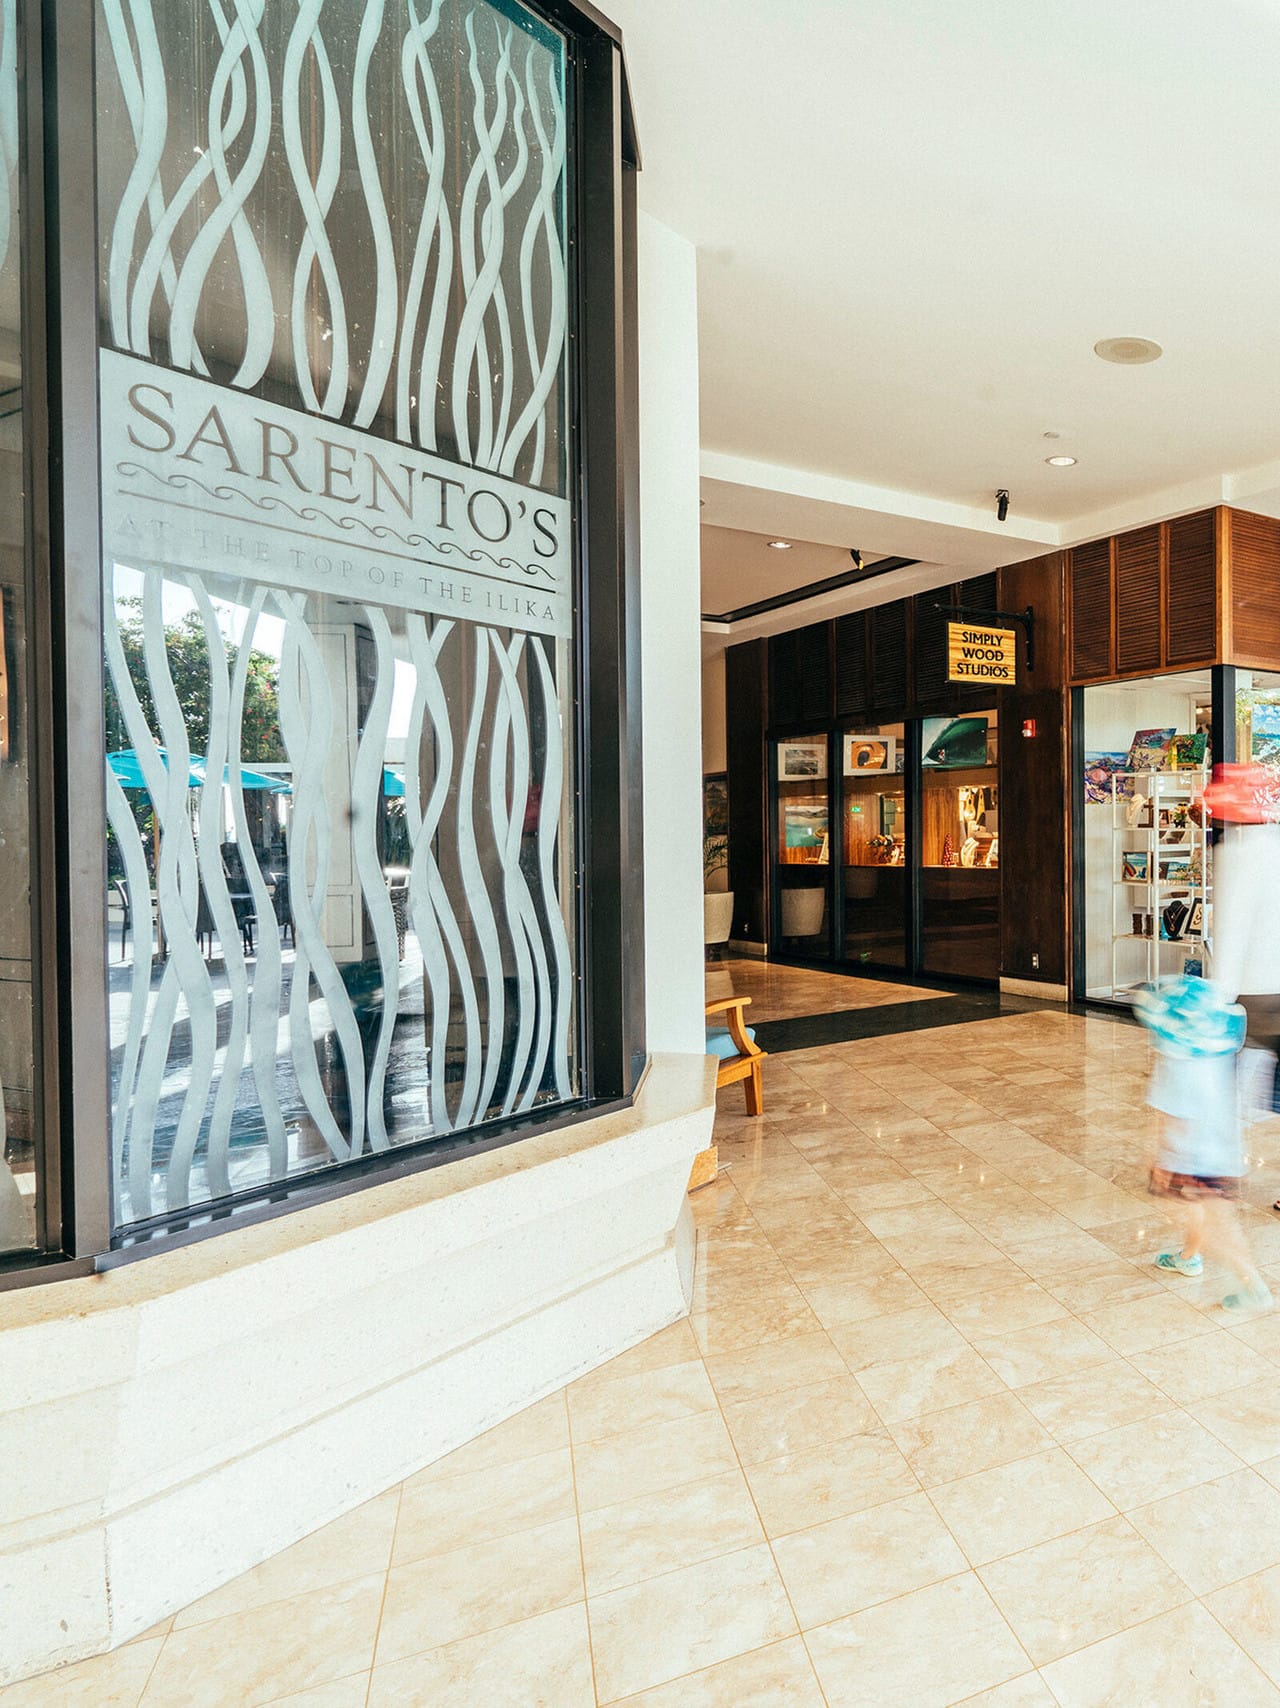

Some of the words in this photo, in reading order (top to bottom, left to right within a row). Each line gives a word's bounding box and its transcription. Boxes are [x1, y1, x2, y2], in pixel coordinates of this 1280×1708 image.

[127, 383, 558, 558] SARENTO'S
[196, 529, 270, 562] THE
[290, 548, 354, 579] TOP
[368, 566, 404, 589] OF
[419, 578, 473, 603] THE
[487, 592, 556, 621] ILIKA
[962, 631, 1003, 646] SIMPLY
[962, 647, 1004, 661] WOOD
[957, 662, 1009, 678] STUDIOS
